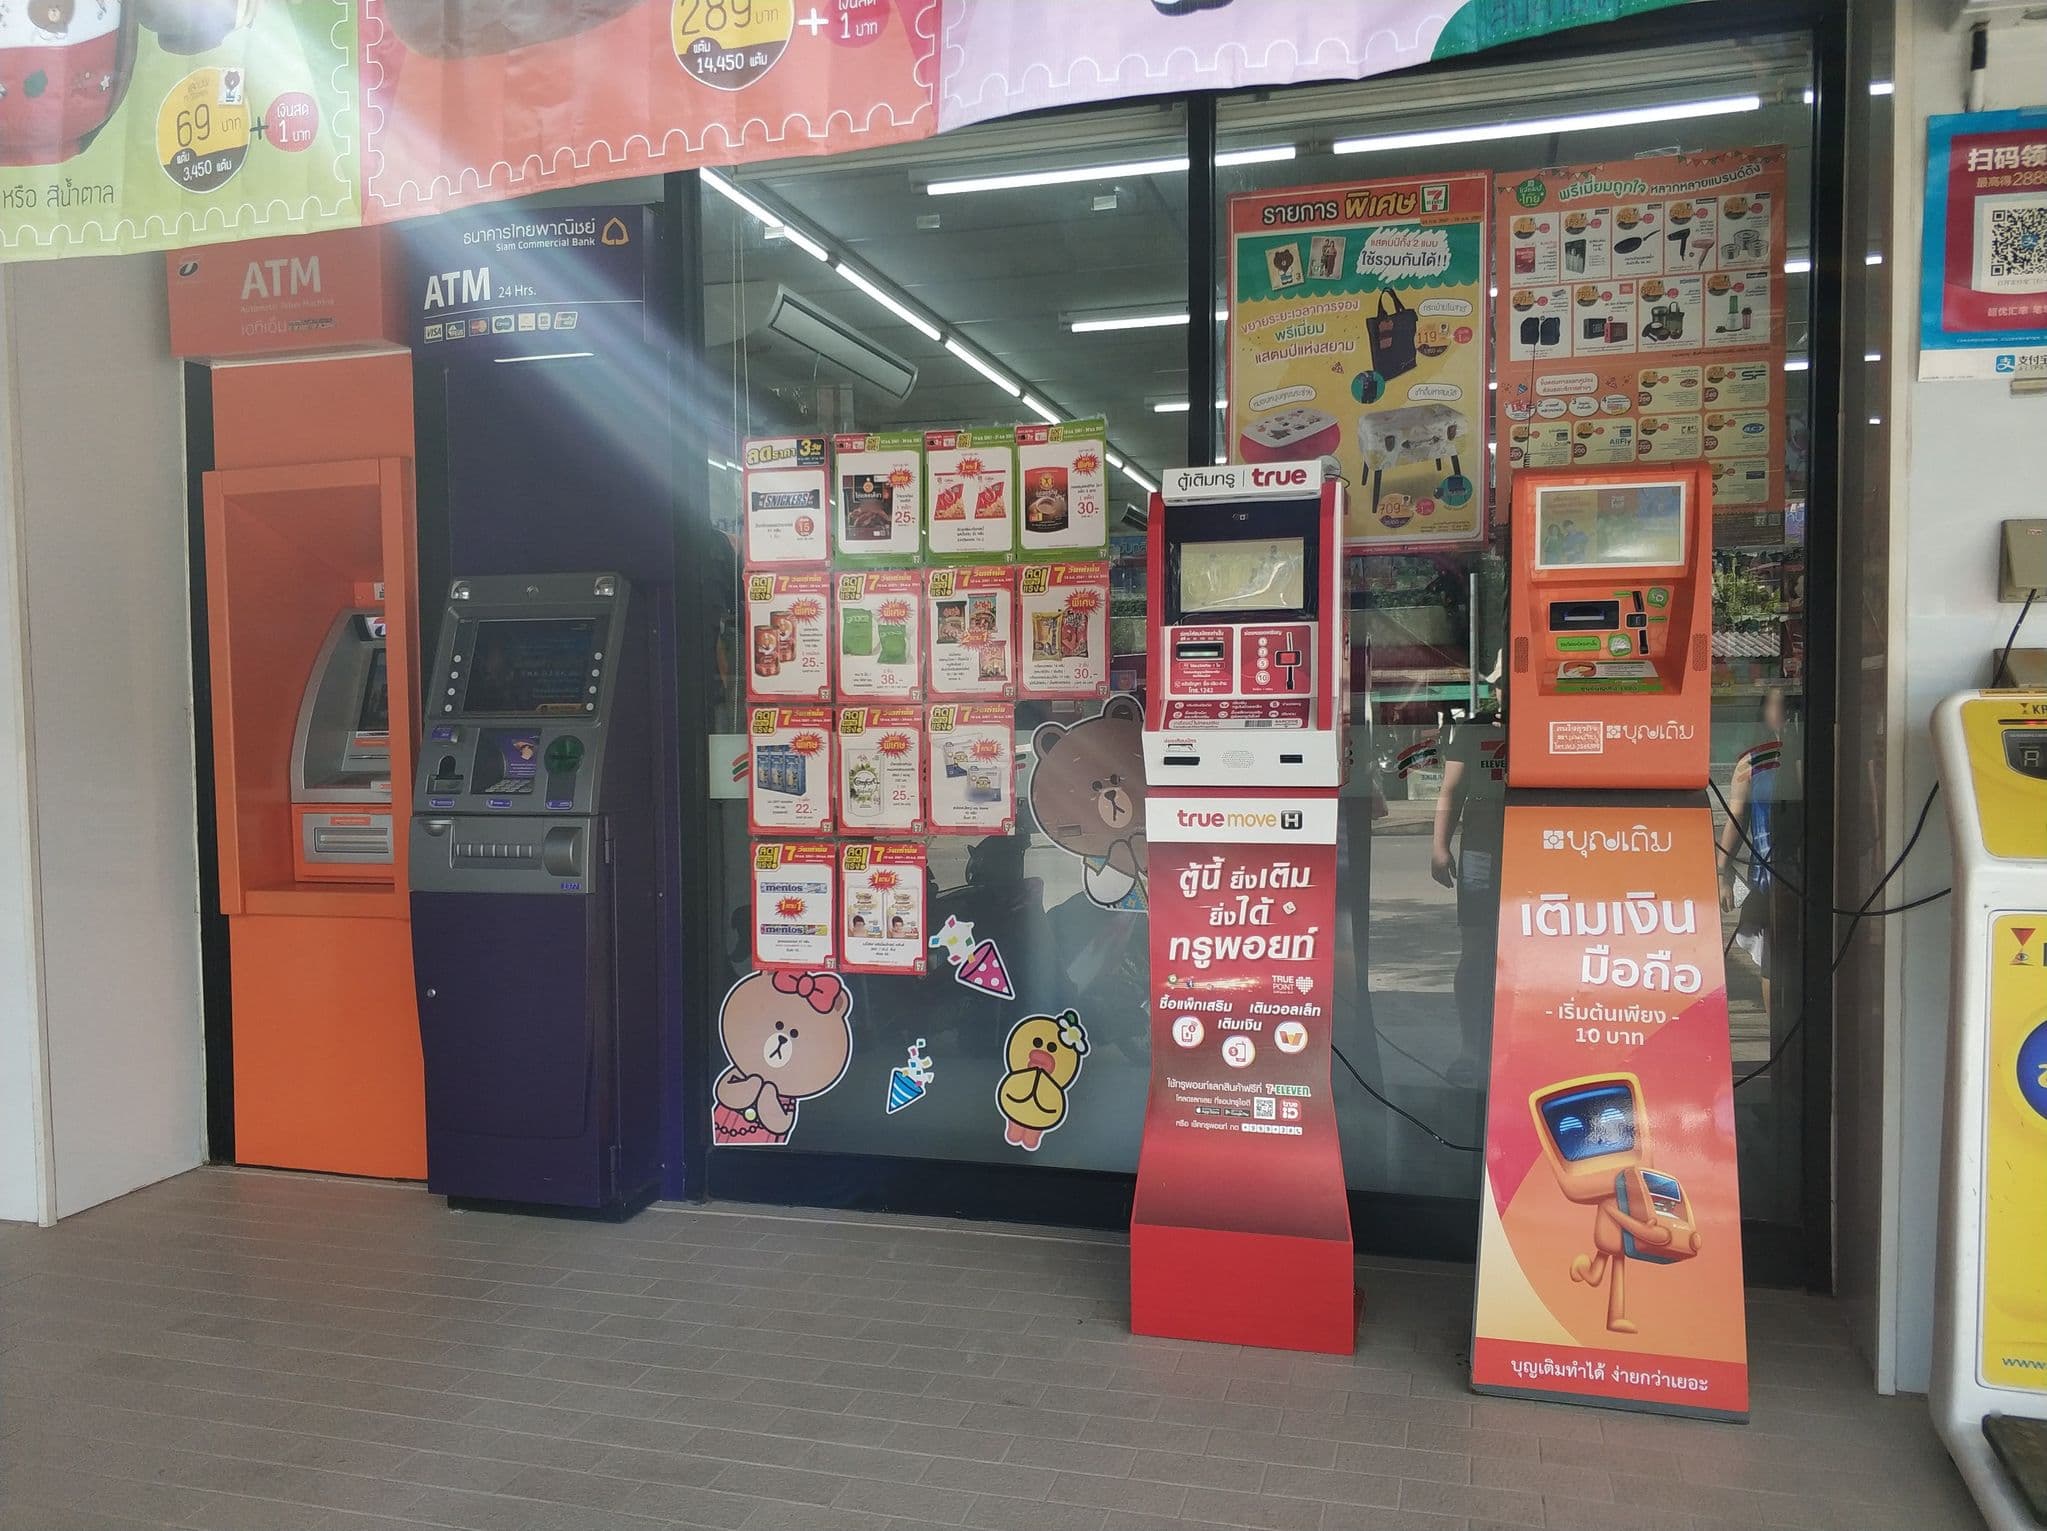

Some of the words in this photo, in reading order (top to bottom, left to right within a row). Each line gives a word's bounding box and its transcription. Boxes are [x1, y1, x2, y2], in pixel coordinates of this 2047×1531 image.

[680, 0, 752, 36] 289
[755, 8, 779, 23] บาท
[840, 13, 851, 39] 1
[856, 22, 878, 36] บาท
[696, 54, 745, 75] 14,450
[277, 102, 310, 118] เงินสด
[176, 103, 210, 148] 69
[221, 116, 241, 133] บาท
[279, 120, 288, 143] 1
[293, 129, 311, 142] บาท
[183, 160, 212, 182] 3,450
[1650, 164, 1762, 195] หลากหลายแบรนด์ดัง
[2, 185, 37, 208] หรือ
[47, 178, 114, 208] สีน้ำตาล
[1263, 201, 1338, 225] รายการ
[1345, 191, 1416, 220] พิเศษ
[463, 218, 596, 245] ธนาคารไทยพาณิชย์
[496, 241, 516, 252] Siam
[518, 239, 569, 250] Commercial
[572, 237, 596, 247] Bank
[1412, 239, 1418, 247] 2
[1361, 251, 1447, 267] ใช้รวมกันได้!!
[240, 255, 321, 300] ATM
[424, 267, 491, 311] ATM
[498, 286, 512, 299] 24
[514, 284, 537, 297] Hrs.
[1240, 300, 1360, 334] ขยายระยะเวลาการจอง
[426, 328, 442, 338] VISA
[1418, 328, 1437, 343] 119
[1255, 340, 1355, 364] แสตมป์แห่งสยาม
[747, 445, 797, 466] ลดราคา
[799, 439, 811, 457] 3
[1177, 472, 1235, 492] ตู้เติมทรู
[1251, 468, 1308, 488] true
[1379, 503, 1400, 515] 709
[778, 576, 790, 591] 7
[869, 575, 880, 591] 7
[959, 571, 972, 587] 7
[1054, 568, 1066, 583] 7
[1071, 598, 1095, 607] พิเศษ
[781, 710, 792, 726] 7
[871, 710, 882, 725] 7
[961, 707, 972, 722] 7
[1624, 720, 1694, 744] บุญเติม
[1567, 824, 1672, 859] บุญเติม
[784, 845, 796, 861] 7
[873, 847, 885, 862] 7
[1179, 856, 1225, 898] ตู้นี้
[1230, 862, 1310, 889] ยิ่งเติม
[765, 884, 803, 892] mentos
[1209, 895, 1274, 926] ยิ่งได้
[1521, 891, 1697, 937] เติมเงิน
[765, 925, 804, 934] mentos
[1169, 926, 1318, 968] ทรูพอยท์
[1272, 975, 1294, 983] TRUE
[1580, 945, 1702, 994] มือถือ
[1159, 995, 1232, 1012] ซื้อแพ็กเสริม
[1250, 1002, 1321, 1016] เติมวอลเล็ท
[1557, 997, 1667, 1024] เริ่มต้นเพียง
[1218, 1018, 1262, 1031] เติมเงิน
[1575, 1028, 1601, 1043] 10
[1606, 1030, 1644, 1046] บาท
[1510, 1358, 1605, 1381] บุญเติมทำได้
[1611, 1369, 1708, 1393] ง่ายกว่าเยอะ
